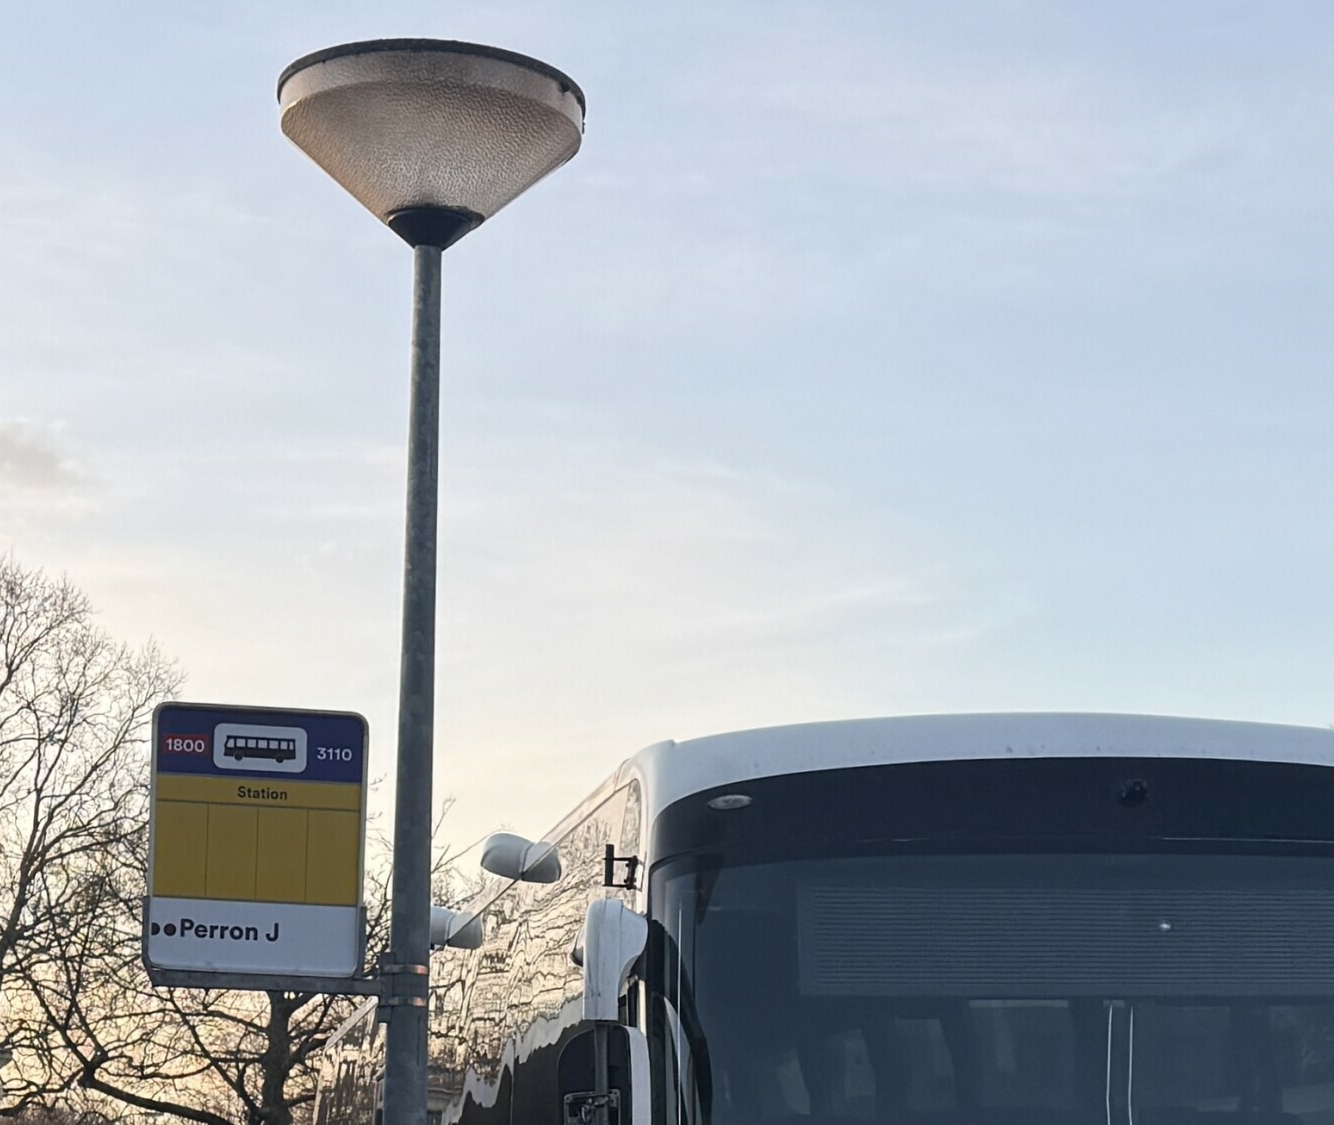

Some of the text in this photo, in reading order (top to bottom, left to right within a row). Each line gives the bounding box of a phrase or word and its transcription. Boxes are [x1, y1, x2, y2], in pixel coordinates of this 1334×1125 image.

[166, 738, 205, 753] 1800
[317, 747, 352, 761] 3110
[237, 786, 288, 800] Station
[180, 918, 279, 942] Perron J
